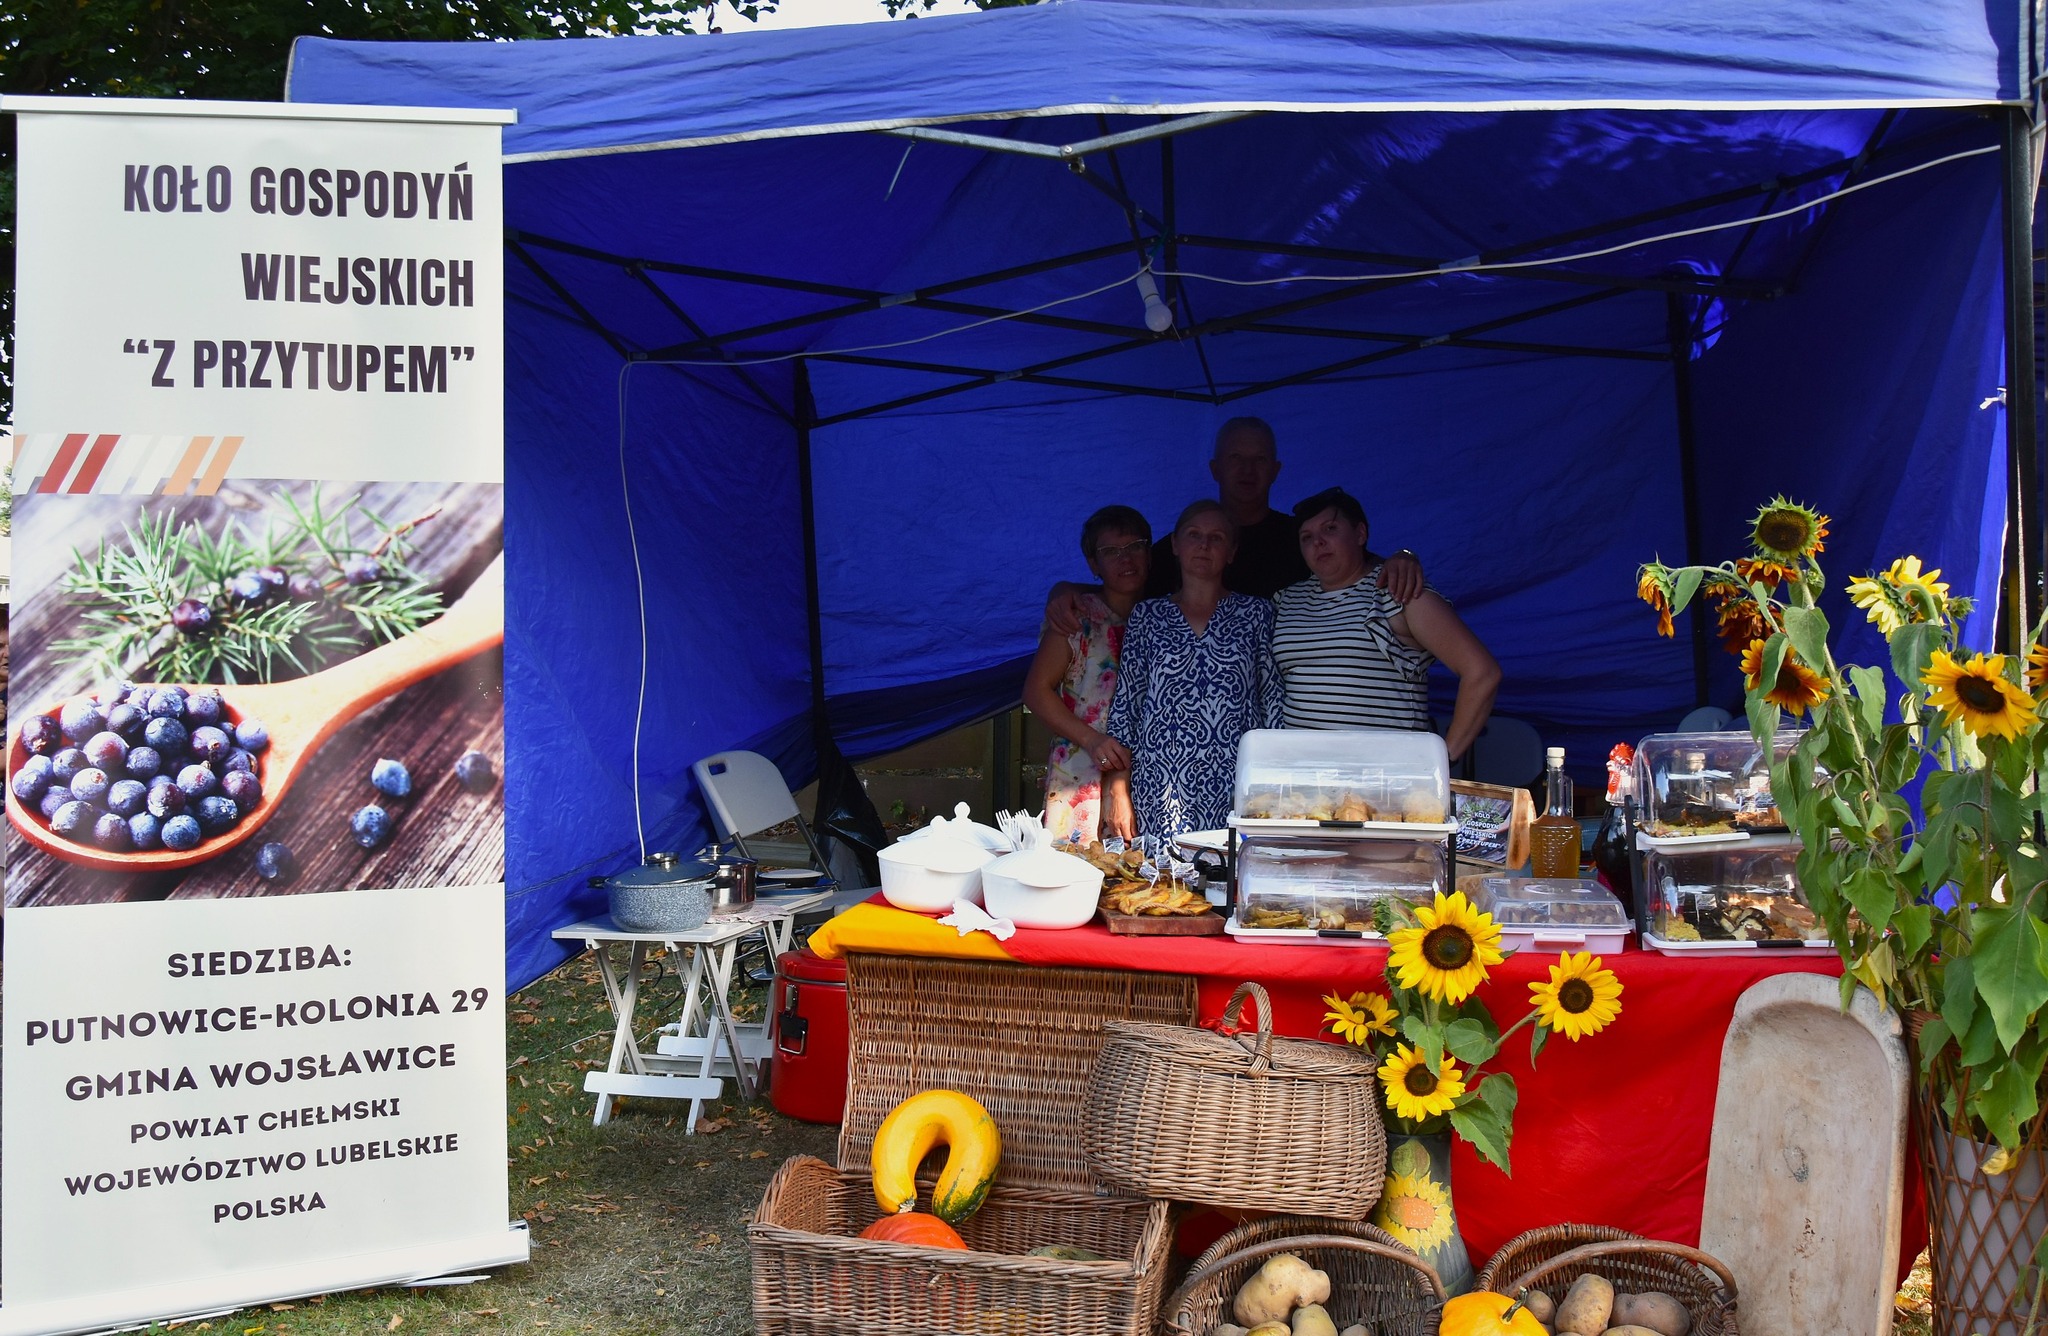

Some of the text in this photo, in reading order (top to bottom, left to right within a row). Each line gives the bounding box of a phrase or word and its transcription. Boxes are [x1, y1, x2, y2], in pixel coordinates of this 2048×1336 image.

[123, 161, 473, 221] KOŁO GOSPODYŃ
[240, 252, 474, 307] WIEJSKICH
[123, 338, 475, 394] “Z PRZYTUPEM”
[167, 944, 352, 978] SIEDZIBA:
[26, 987, 489, 1047] PUTNOWICE-KOLONIA 29
[65, 1043, 456, 1101] GMINA WOJSŁAWICE
[130, 1097, 401, 1144] POWIAT CHEŁMSKI
[63, 1133, 459, 1197] WOJEWÓDZTWO LUBELSKIE
[214, 1191, 327, 1224] POLSKA
